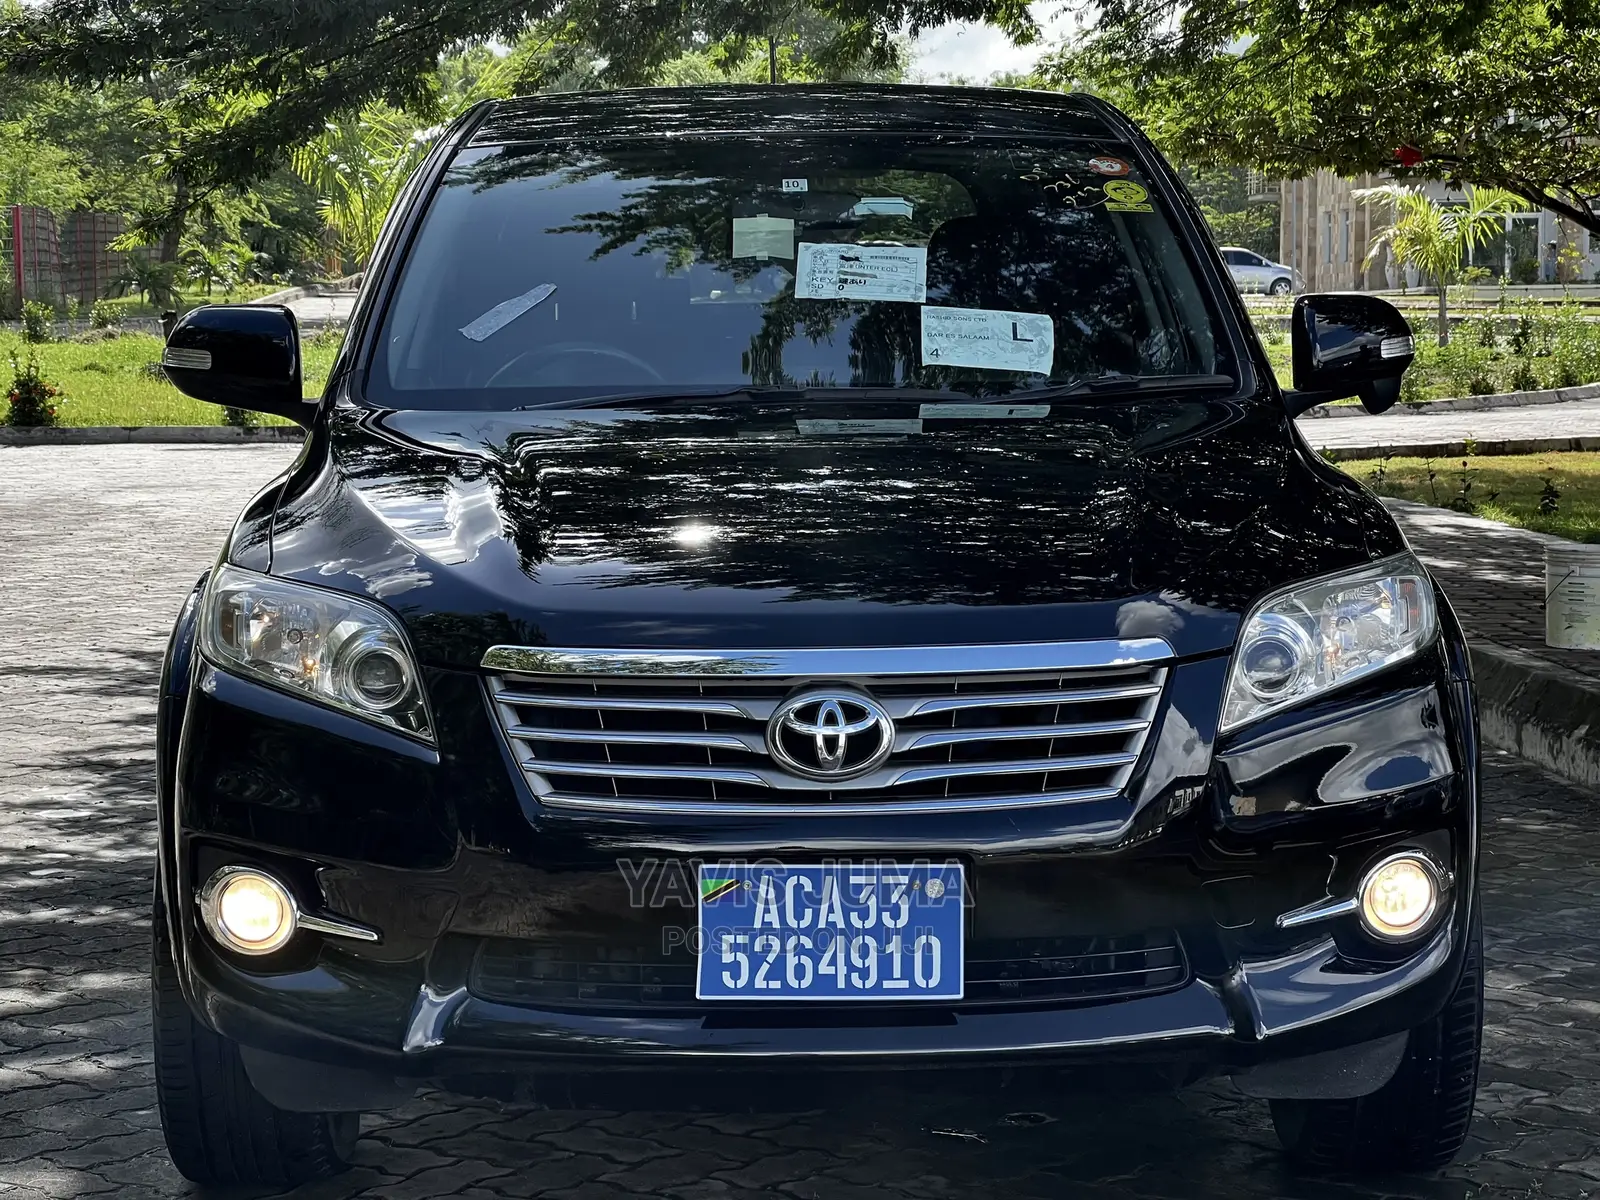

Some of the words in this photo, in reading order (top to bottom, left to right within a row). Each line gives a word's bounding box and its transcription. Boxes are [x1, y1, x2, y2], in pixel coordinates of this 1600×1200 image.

[1011, 321, 1034, 342] L
[929, 348, 940, 358] 4
[752, 875, 910, 929] ACA33
[721, 934, 942, 989] 5264910
